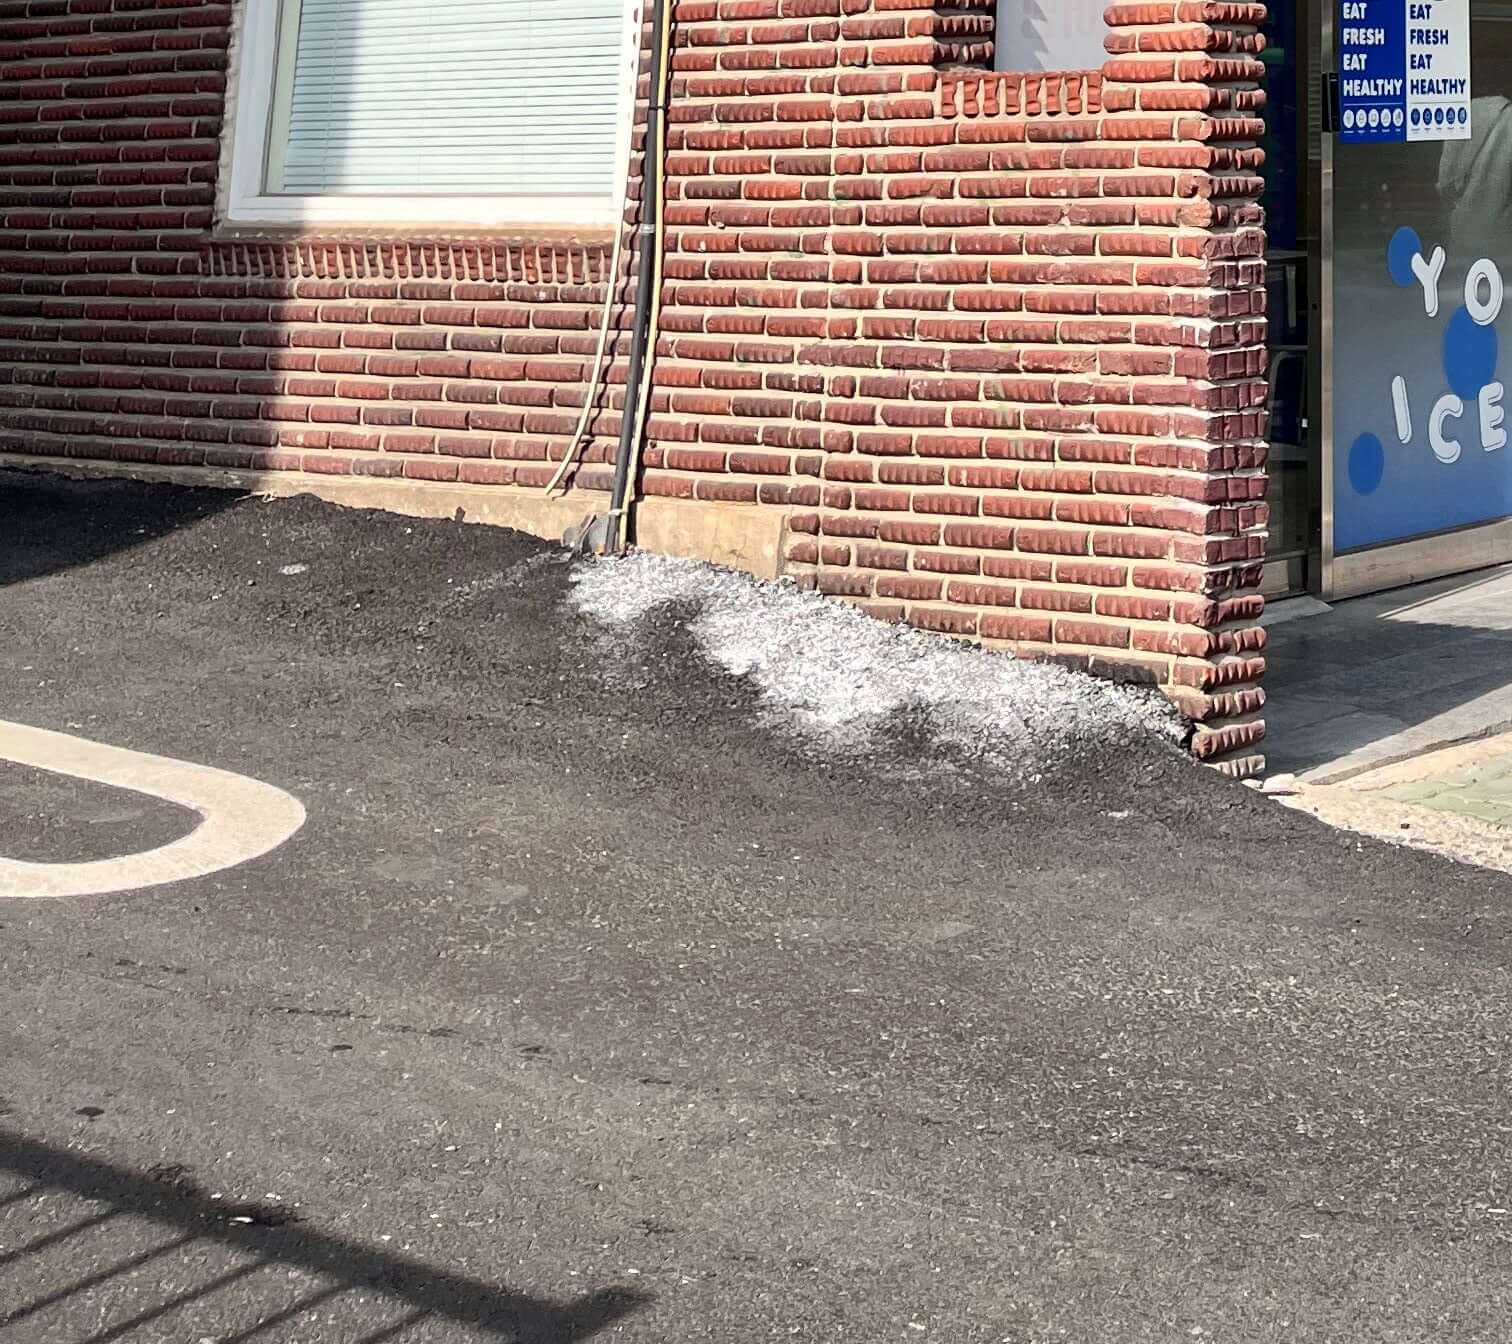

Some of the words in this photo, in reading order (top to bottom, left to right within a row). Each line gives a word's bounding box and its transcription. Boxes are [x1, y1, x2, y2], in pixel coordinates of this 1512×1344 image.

[1343, 2, 1368, 20] EAT
[1409, 4, 1433, 20] EAT
[1343, 27, 1385, 45] FRESH
[1409, 29, 1449, 45] FRESH
[1343, 53, 1368, 71] EAT
[1410, 54, 1433, 70] EAT
[1343, 78, 1403, 97] HEALTHY
[1410, 78, 1467, 95] HEALTHY
